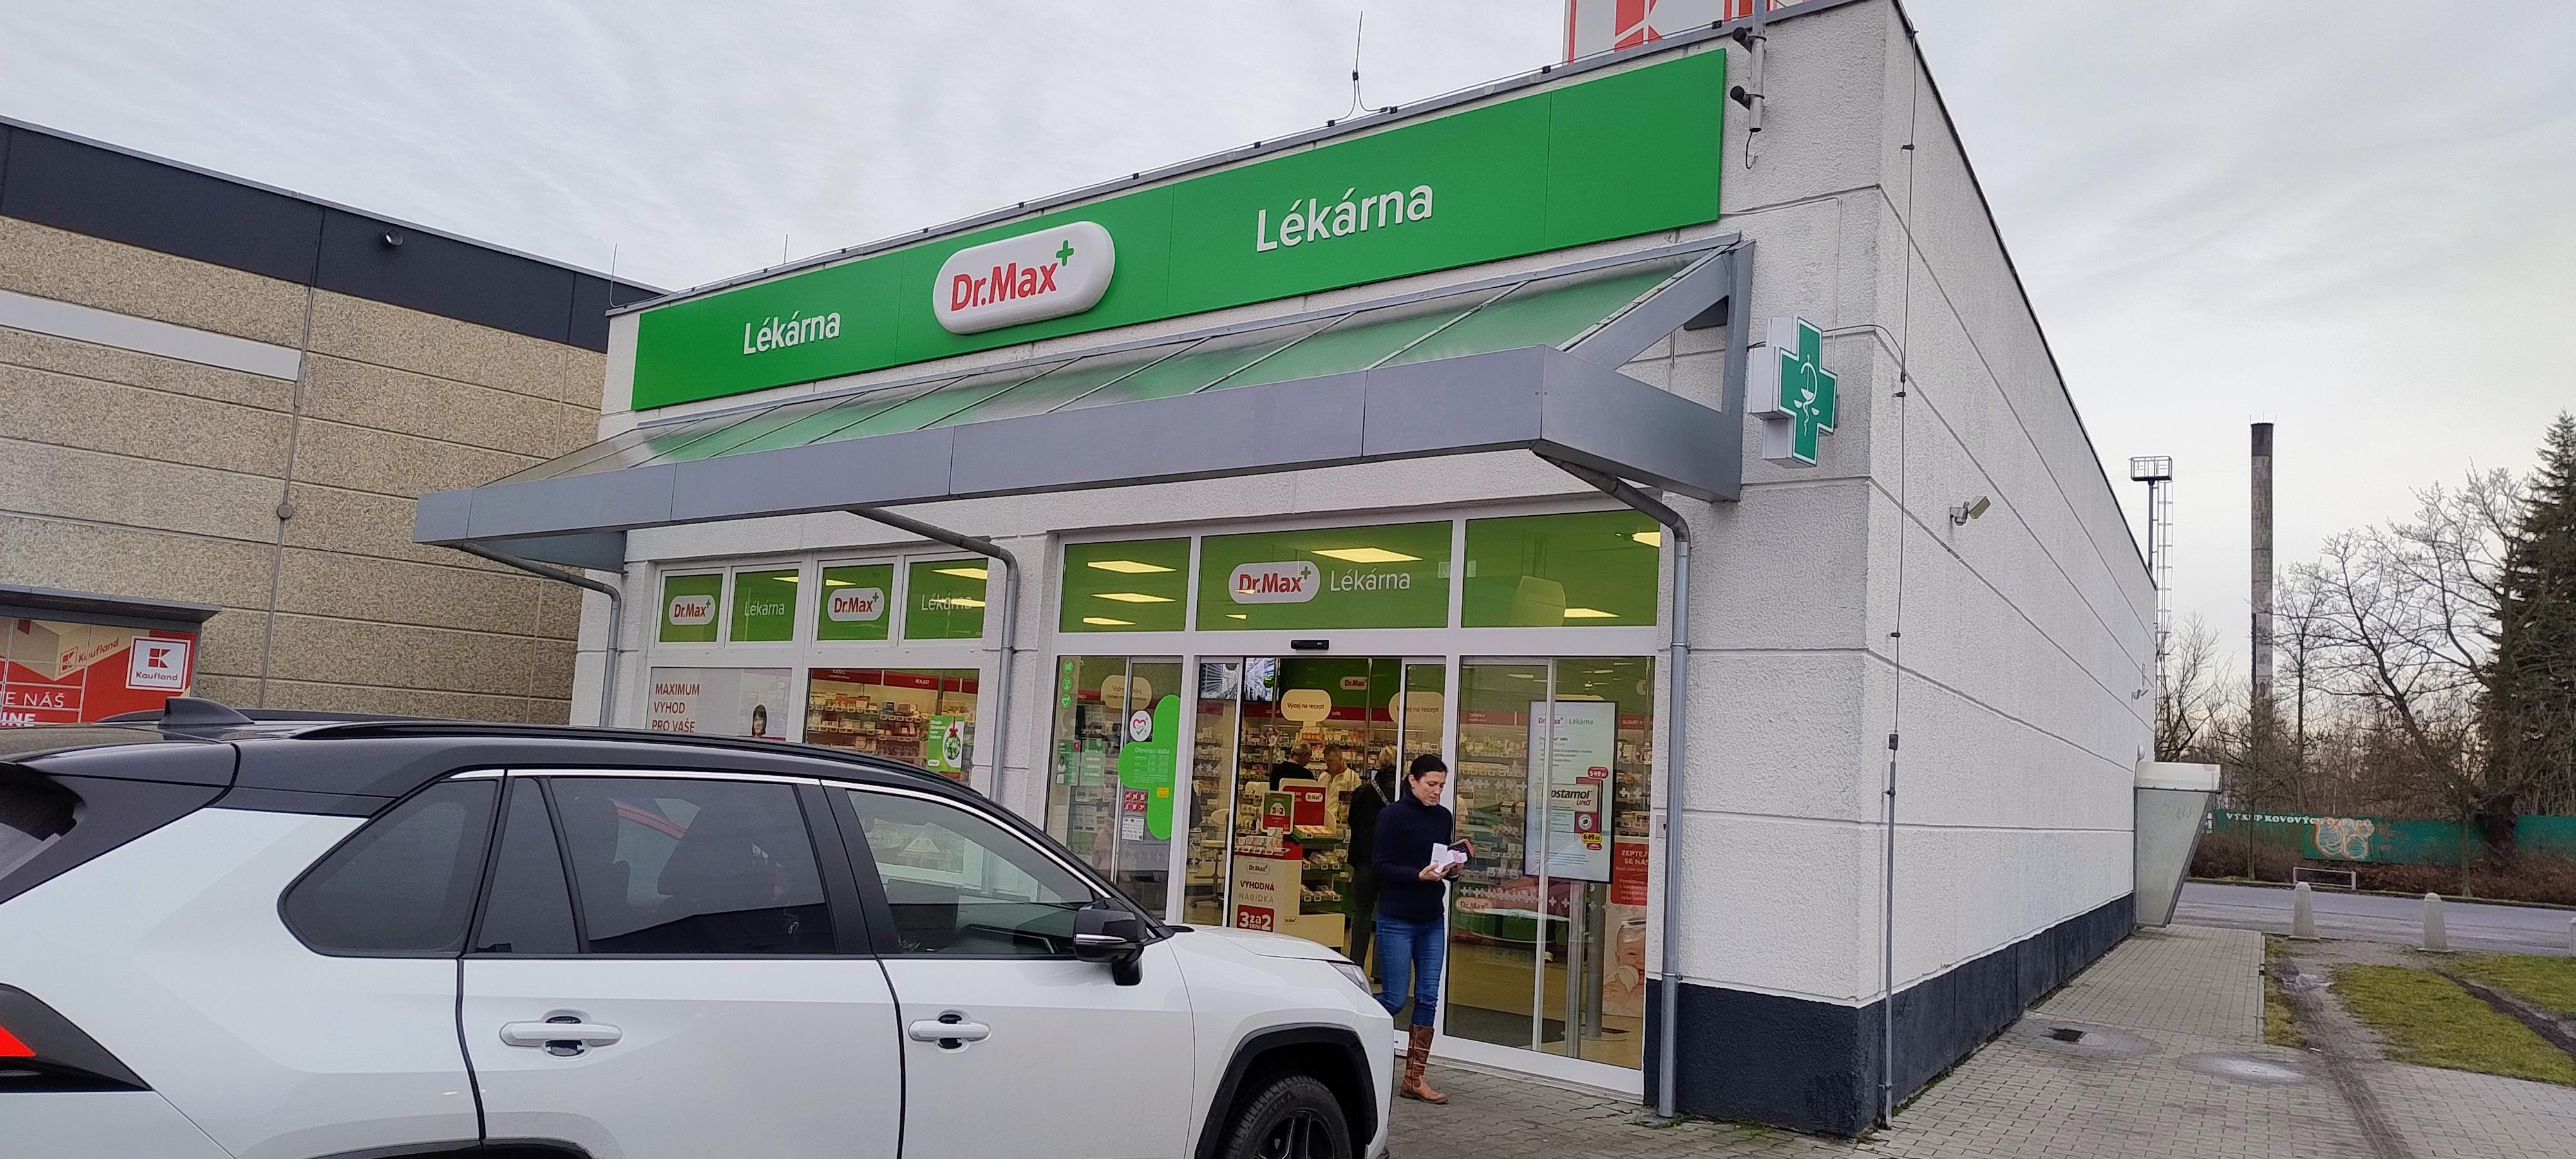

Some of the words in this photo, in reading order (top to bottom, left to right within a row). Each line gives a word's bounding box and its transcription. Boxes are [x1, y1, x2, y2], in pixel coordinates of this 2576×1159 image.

[1256, 185, 1434, 252] Lékárna
[951, 262, 1059, 312] Dr.Max
[743, 310, 841, 355] Lékárna
[1238, 572, 1302, 594] Dr.Max
[1330, 567, 1411, 592] Lékárna
[674, 603, 706, 618] Dr.Max
[744, 599, 785, 617] Lékárna
[833, 597, 873, 613] Dr.Max
[136, 671, 178, 681] Kaufland
[655, 683, 700, 696] MAXIMUM
[23, 691, 65, 708] NÁŠ
[654, 700, 685, 714] VÝHOD
[652, 720, 670, 731] PRO
[672, 717, 696, 733] VAŠE
[1551, 789, 1590, 799] ostamol
[1240, 878, 1275, 892] VÝHODNÁ
[1238, 892, 1274, 904] NABÍDKA
[1239, 911, 1249, 928] 3
[1249, 915, 1262, 924] za
[1261, 914, 1272, 931] 2
